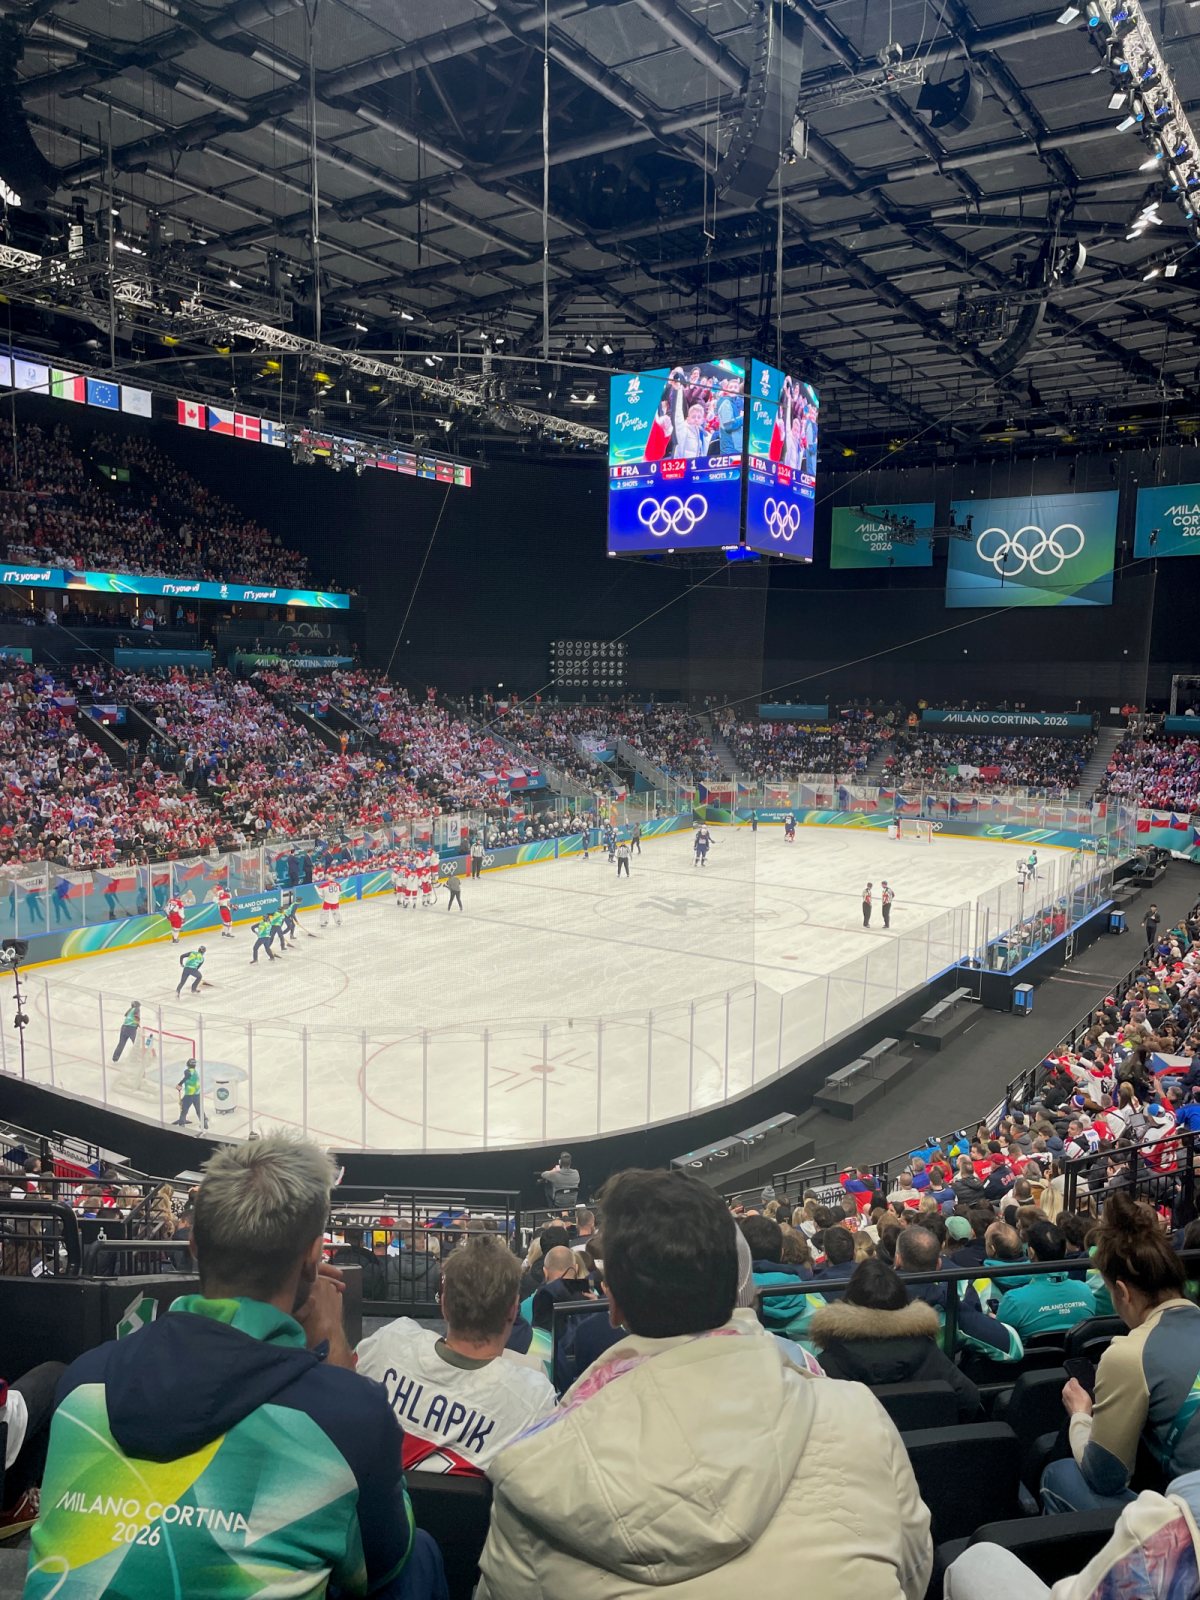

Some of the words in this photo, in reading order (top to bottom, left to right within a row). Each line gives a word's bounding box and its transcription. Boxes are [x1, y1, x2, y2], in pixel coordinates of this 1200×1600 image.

[622, 466, 640, 476] FRA
[650, 464, 657, 473] 0
[662, 462, 685, 472] 13:24
[691, 460, 696, 470] 1
[708, 456, 729, 468] CZE
[756, 459, 766, 471] FRA
[793, 471, 796, 480] 1
[1172, 516, 1200, 526] COR
[854, 524, 892, 533] MILAN
[870, 542, 892, 551] 2026
[288, 659, 322, 668] CORTINA
[942, 714, 990, 723] MILANO
[991, 715, 1041, 725] CORTINA
[1044, 716, 1068, 726] 2026
[1039, 1304, 1063, 1312] MILANO
[56, 1491, 140, 1518] MILANO
[145, 1502, 252, 1534] CORTINA
[112, 1522, 161, 1546] 2026
